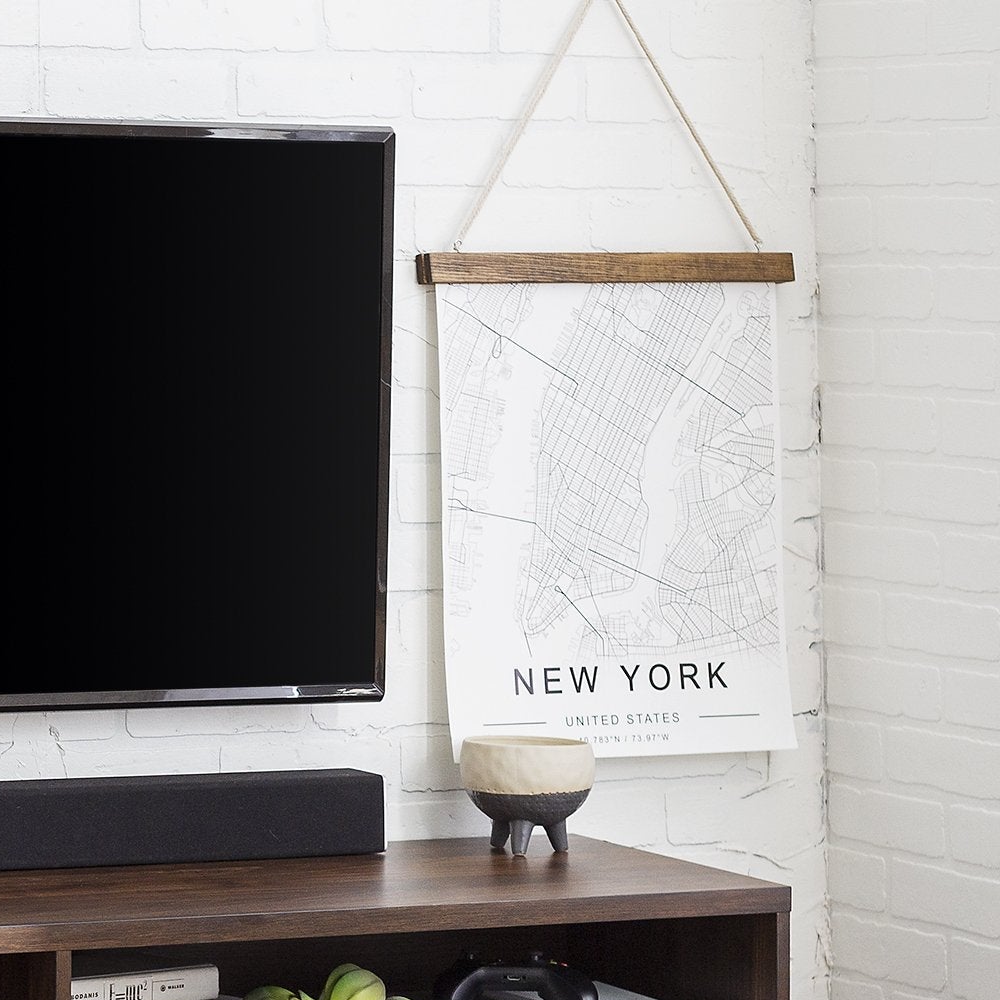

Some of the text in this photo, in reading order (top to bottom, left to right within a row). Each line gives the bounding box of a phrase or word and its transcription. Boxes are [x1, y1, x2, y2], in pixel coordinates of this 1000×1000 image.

[514, 661, 729, 696] NEW YORK
[565, 711, 681, 728] UNITED STATES
